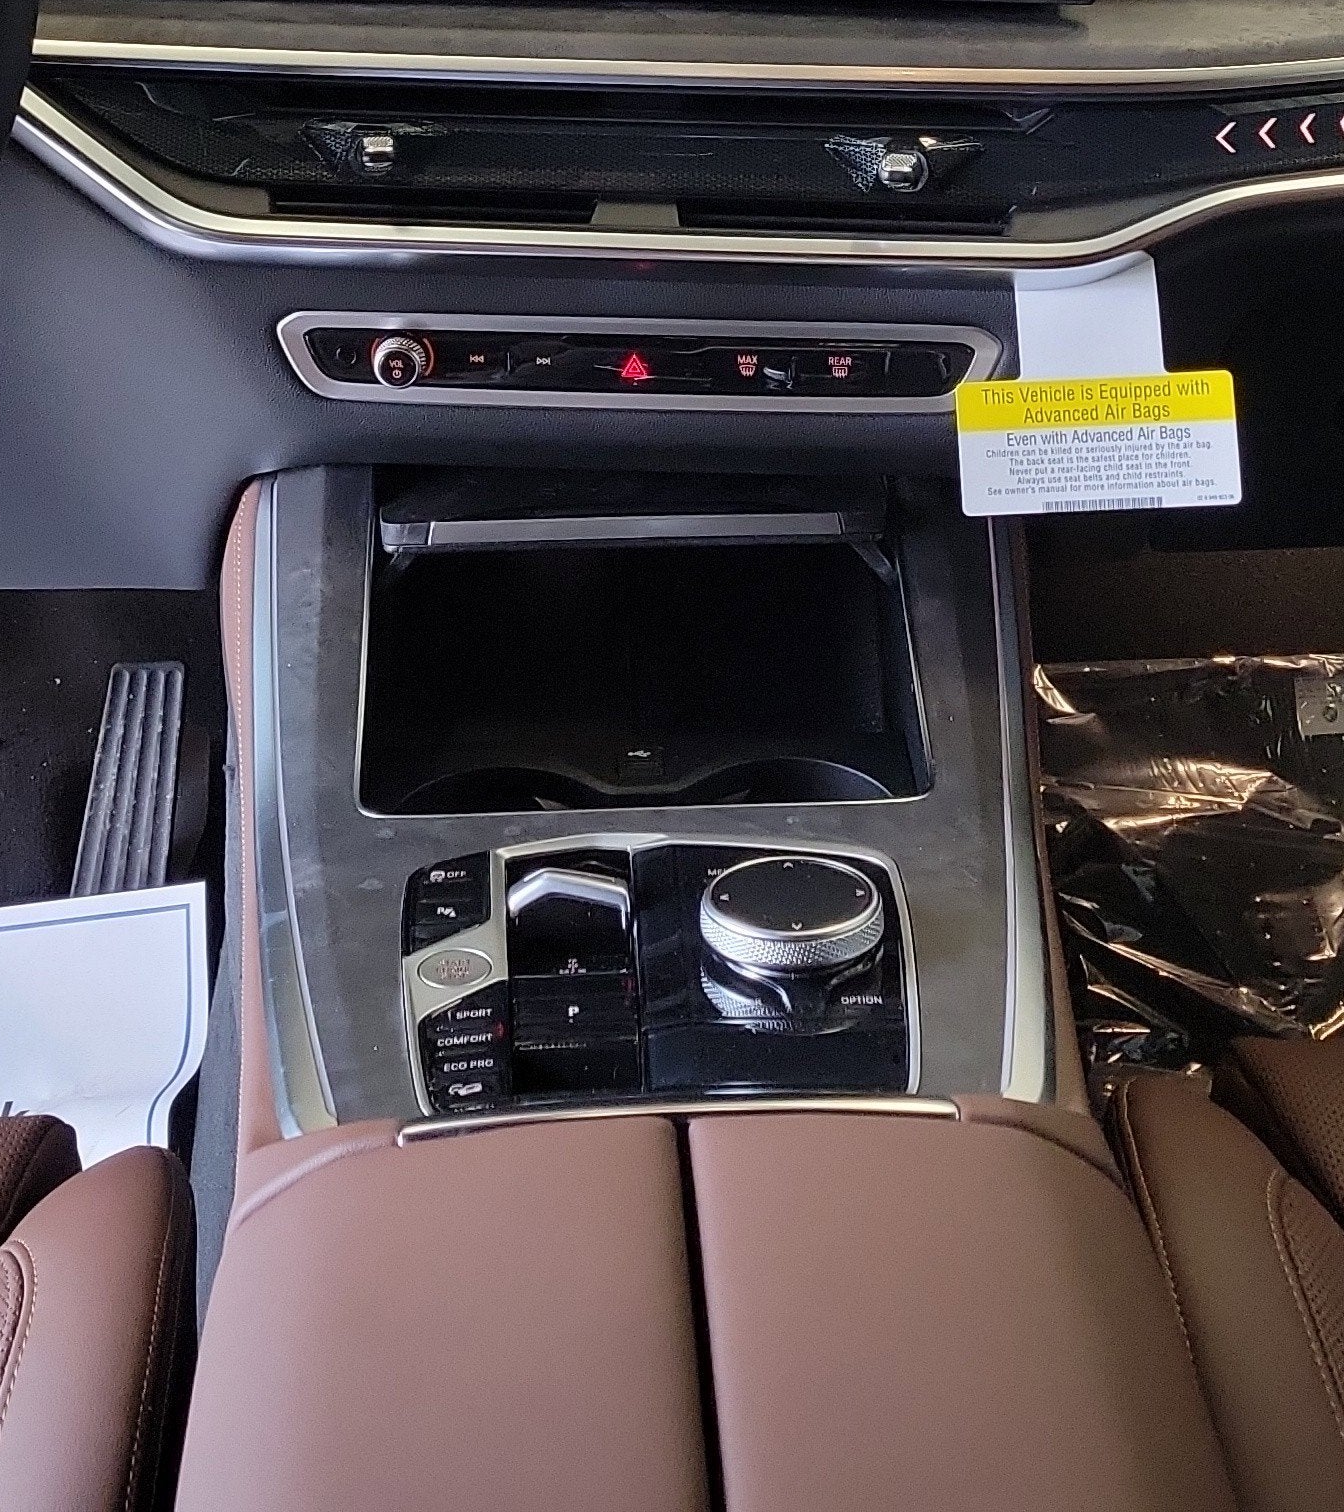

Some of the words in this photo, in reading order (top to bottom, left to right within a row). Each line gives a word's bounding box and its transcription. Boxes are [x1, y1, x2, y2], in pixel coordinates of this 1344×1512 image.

[389, 359, 403, 368] VOL
[737, 354, 758, 365] MAX
[828, 356, 852, 367] REAR
[981, 388, 1014, 405] This
[1019, 385, 1075, 404] Vehicle
[1080, 384, 1094, 401] is
[1099, 380, 1171, 402] Equipped
[1177, 379, 1210, 396] with
[1024, 404, 1099, 424] Advanced
[1105, 403, 1127, 421] Air
[1132, 402, 1171, 422] Bags
[1006, 432, 1036, 447] Even
[1040, 430, 1067, 445] with
[1072, 427, 1133, 444] Advanced
[1137, 426, 1155, 441] Air
[1159, 425, 1191, 441] Bags
[986, 449, 1019, 458] Children
[1038, 447, 1048, 456] be
[1050, 446, 1072, 455] killed
[1085, 443, 1122, 454] seriously
[1124, 442, 1153, 452] injured
[1155, 442, 1165, 452] by
[1167, 441, 1180, 450] the
[1182, 441, 1193, 449] air
[1009, 458, 1024, 466] The
[1026, 457, 1044, 466] back
[1047, 456, 1064, 465] seat
[1066, 456, 1074, 464] is
[1075, 455, 1089, 464] the
[1091, 454, 1116, 463] safest
[1118, 453, 1139, 462] place
[1141, 452, 1153, 460] for
[1009, 468, 1032, 476] Never
[1034, 467, 1047, 476] put
[1057, 464, 1101, 473] rear-facing
[1103, 462, 1123, 472] child
[1125, 462, 1142, 471] seat
[1155, 461, 1168, 469] the
[1017, 476, 1045, 486] Always
[1047, 476, 1062, 484] use
[1064, 475, 1081, 483] seat
[1083, 473, 1103, 482] belts
[1105, 472, 1121, 481] and
[1122, 470, 1142, 480] child
[987, 487, 1002, 496] See
[1004, 485, 1036, 495] owner's
[1038, 484, 1067, 494] manual
[1069, 483, 1081, 492] for
[1083, 483, 1104, 491] more
[1107, 480, 1154, 490] information
[1156, 479, 1179, 488] about
[1181, 478, 1193, 487] air
[840, 996, 883, 1005] OPTION
[456, 1008, 493, 1020] SPORT
[568, 1005, 580, 1017] P
[437, 1033, 494, 1047] COMFORT
[444, 1061, 468, 1073] ECO
[470, 1059, 494, 1071] PRO
